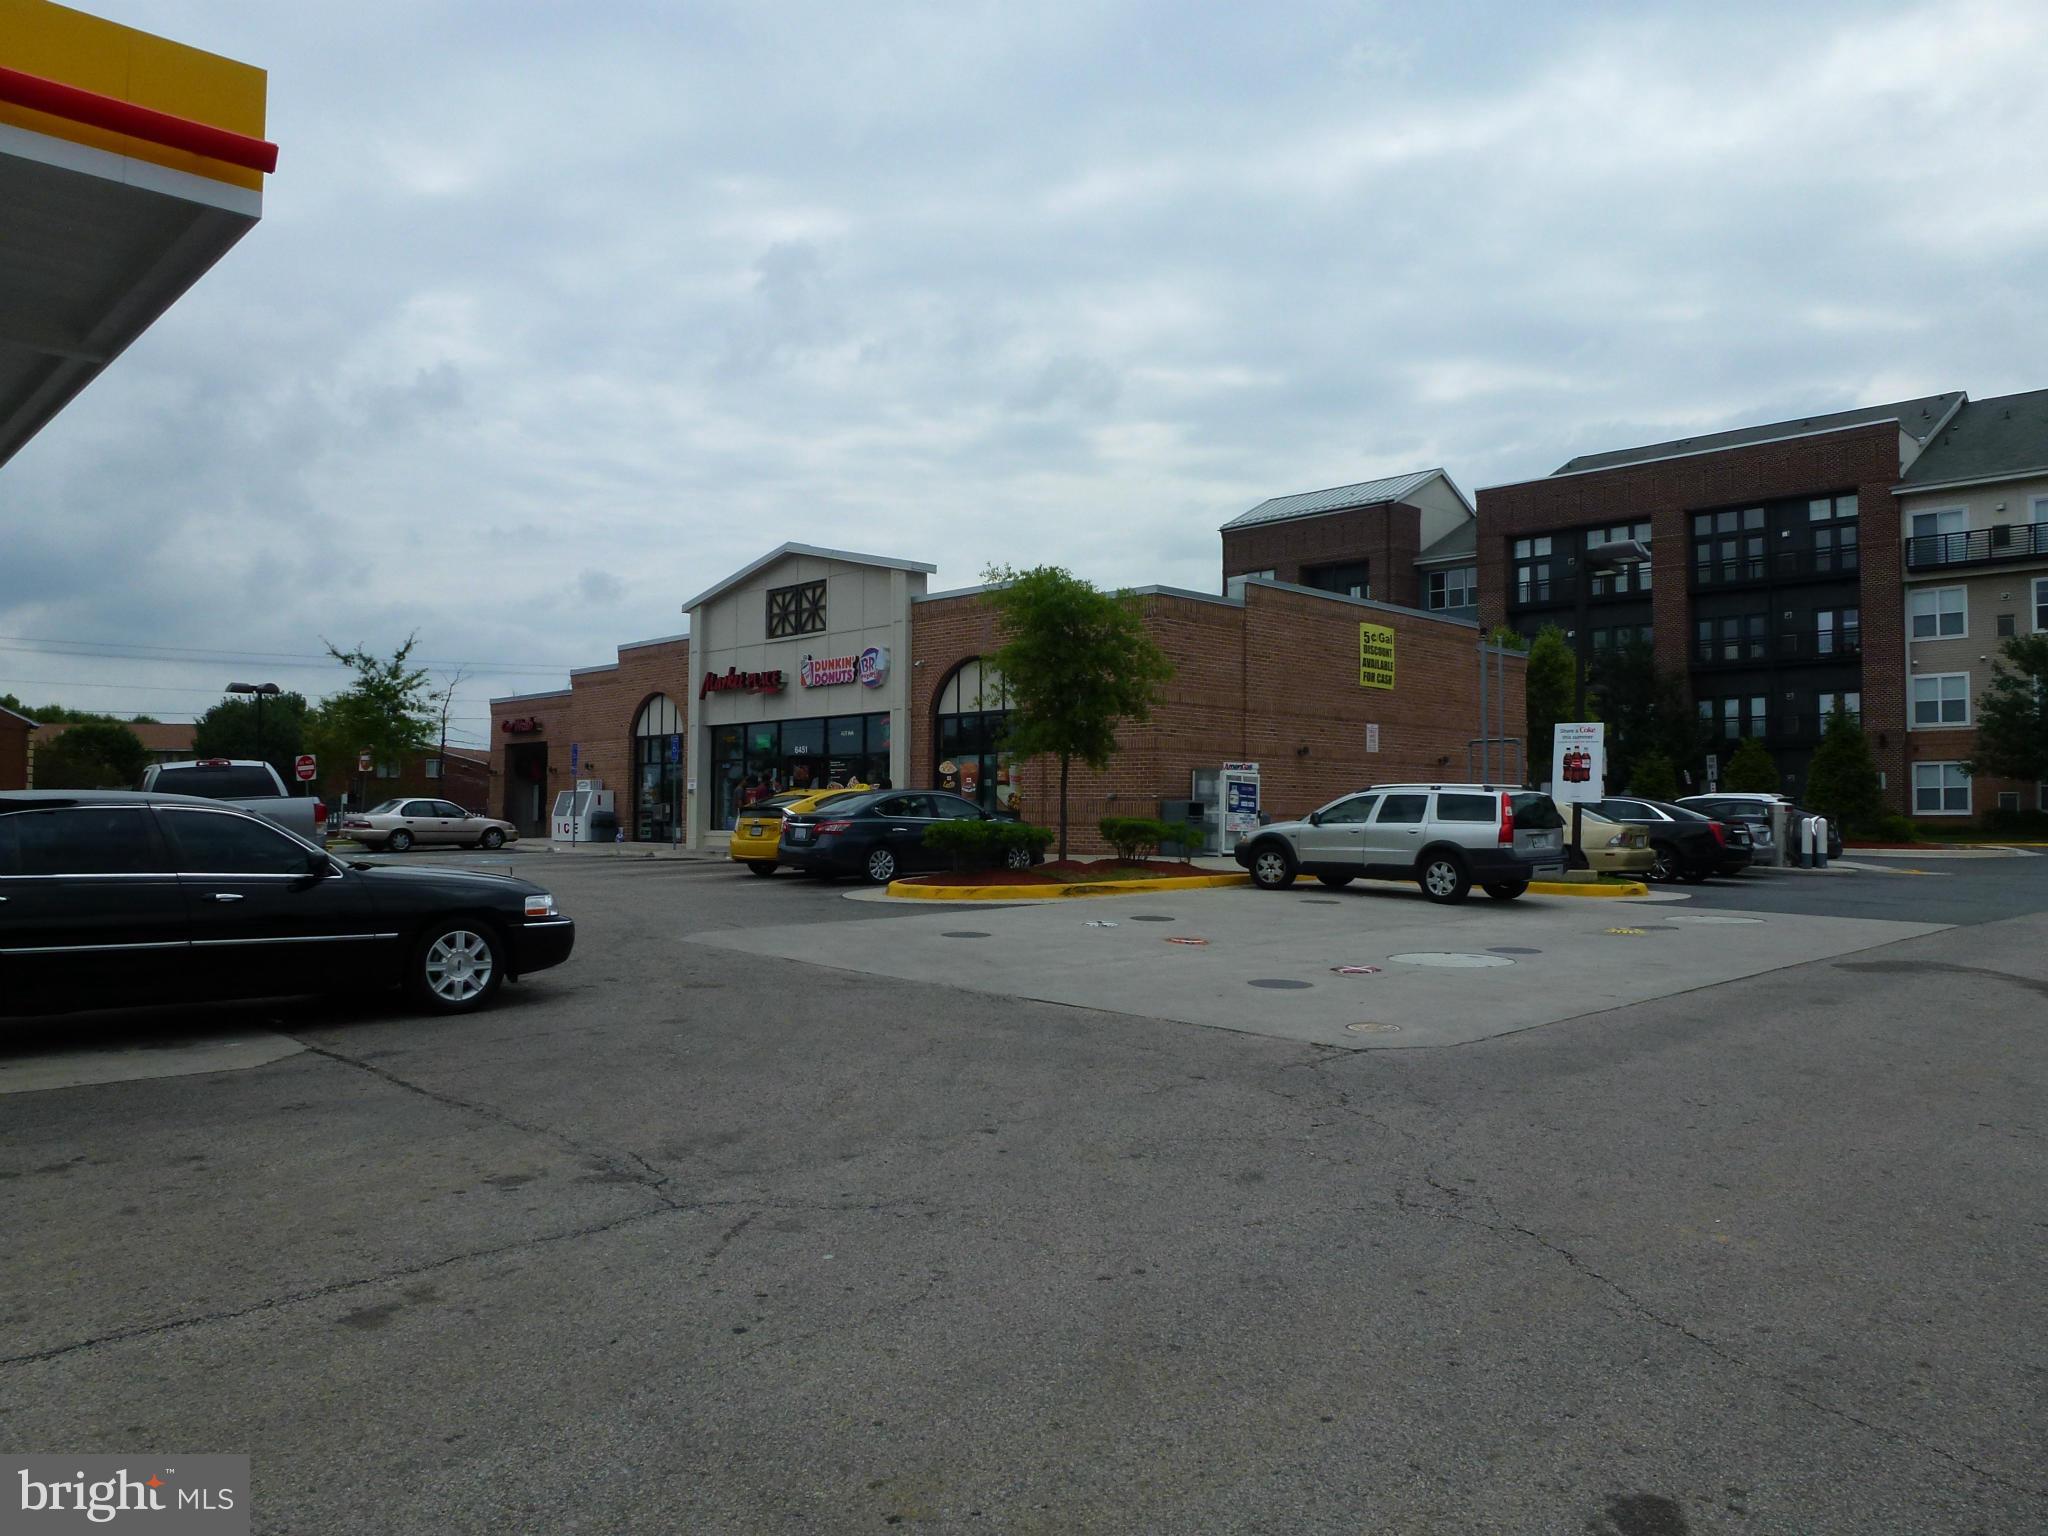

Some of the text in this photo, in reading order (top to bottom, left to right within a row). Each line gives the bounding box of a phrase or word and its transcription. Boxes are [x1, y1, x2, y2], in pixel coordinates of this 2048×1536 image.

[1363, 644, 1392, 658] DISCOUNT
[814, 655, 854, 673] DUNKIN'
[861, 657, 876, 673] BR
[1362, 657, 1393, 672] AVAILABLE
[814, 669, 854, 686] DONUTS
[1363, 671, 1392, 685] FOR CASH
[794, 745, 808, 754] 6451
[557, 823, 579, 834] ICE
